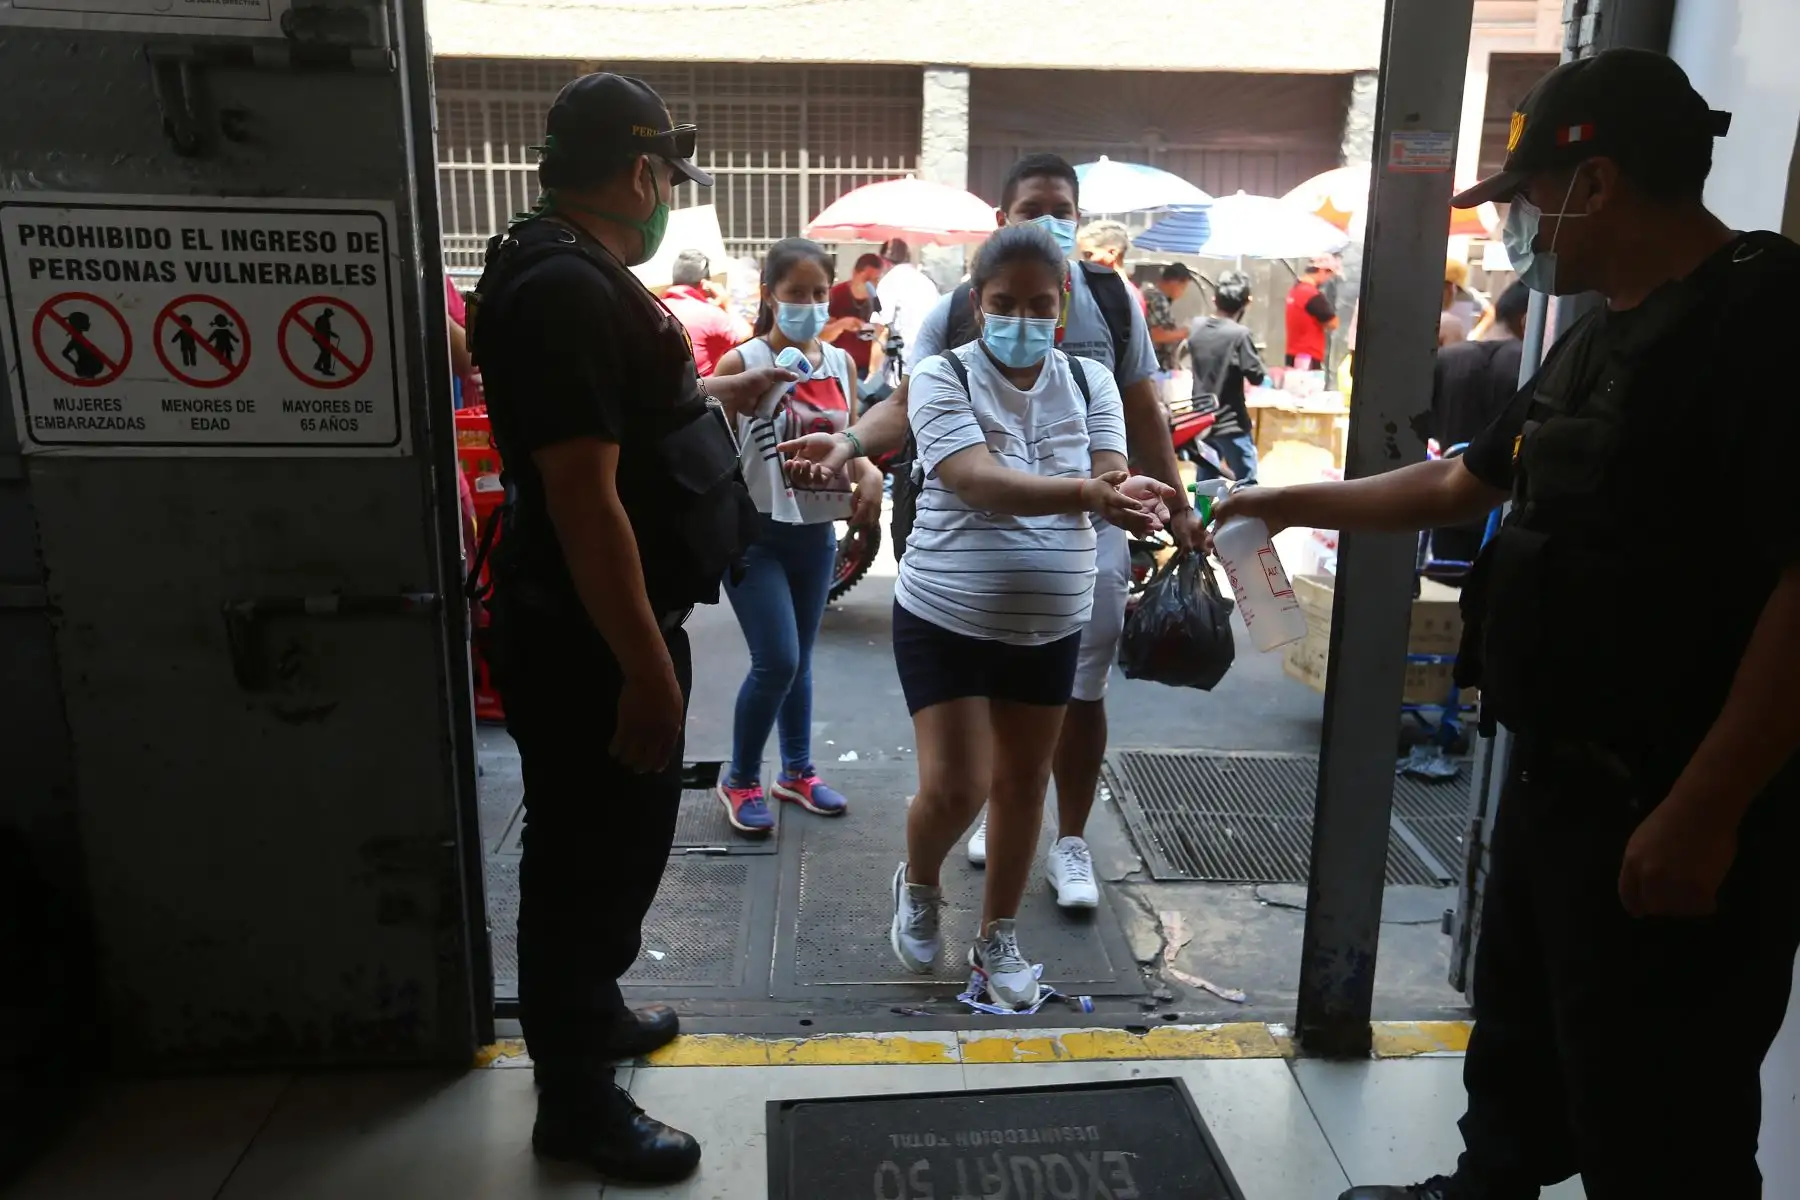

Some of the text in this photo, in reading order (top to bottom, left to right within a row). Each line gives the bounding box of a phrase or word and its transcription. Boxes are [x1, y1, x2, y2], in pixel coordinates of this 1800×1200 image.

[18, 224, 380, 254] PROHIBIDO EL INGRESO DE
[29, 257, 377, 286] PERSONAS VULNERABLES
[53, 398, 123, 412] MUJERES
[161, 399, 256, 413] MENORES DE
[282, 399, 374, 414] MAYORES DE
[35, 416, 146, 430] EMBARAZADAS
[190, 418, 231, 431] EDAD
[300, 415, 359, 432] 65 AÑOS
[889, 1132, 952, 1149] TOTAL
